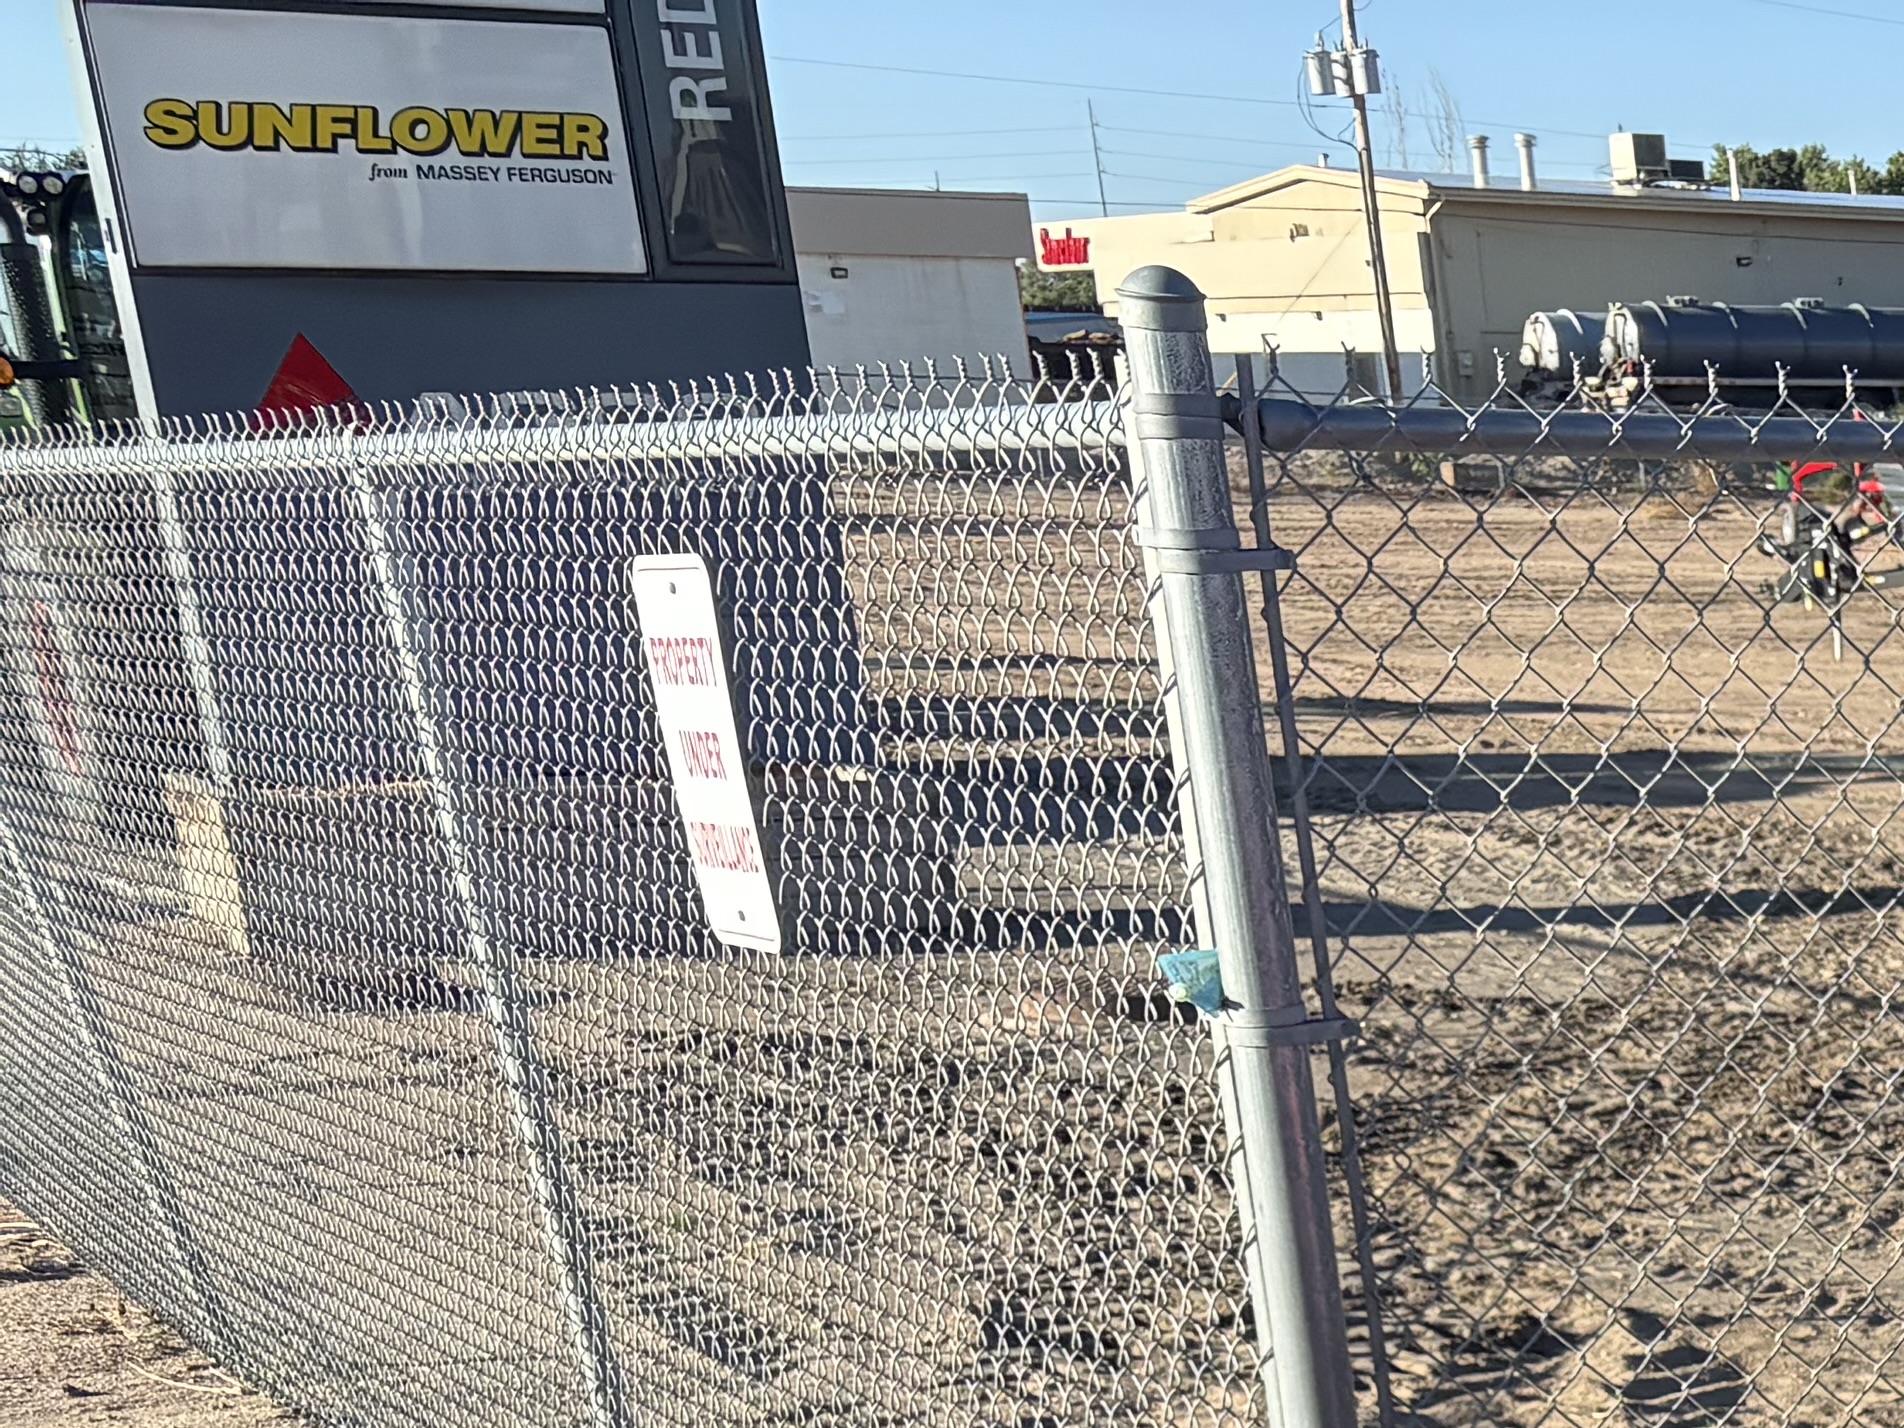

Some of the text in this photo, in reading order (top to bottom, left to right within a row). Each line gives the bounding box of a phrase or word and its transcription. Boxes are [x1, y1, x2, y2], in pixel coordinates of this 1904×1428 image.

[143, 97, 609, 161] SUNFLOWER
[368, 163, 613, 185] from MASSEY FERGUSON
[650, 637, 717, 687] PROPERTY
[679, 729, 728, 781] UNDER
